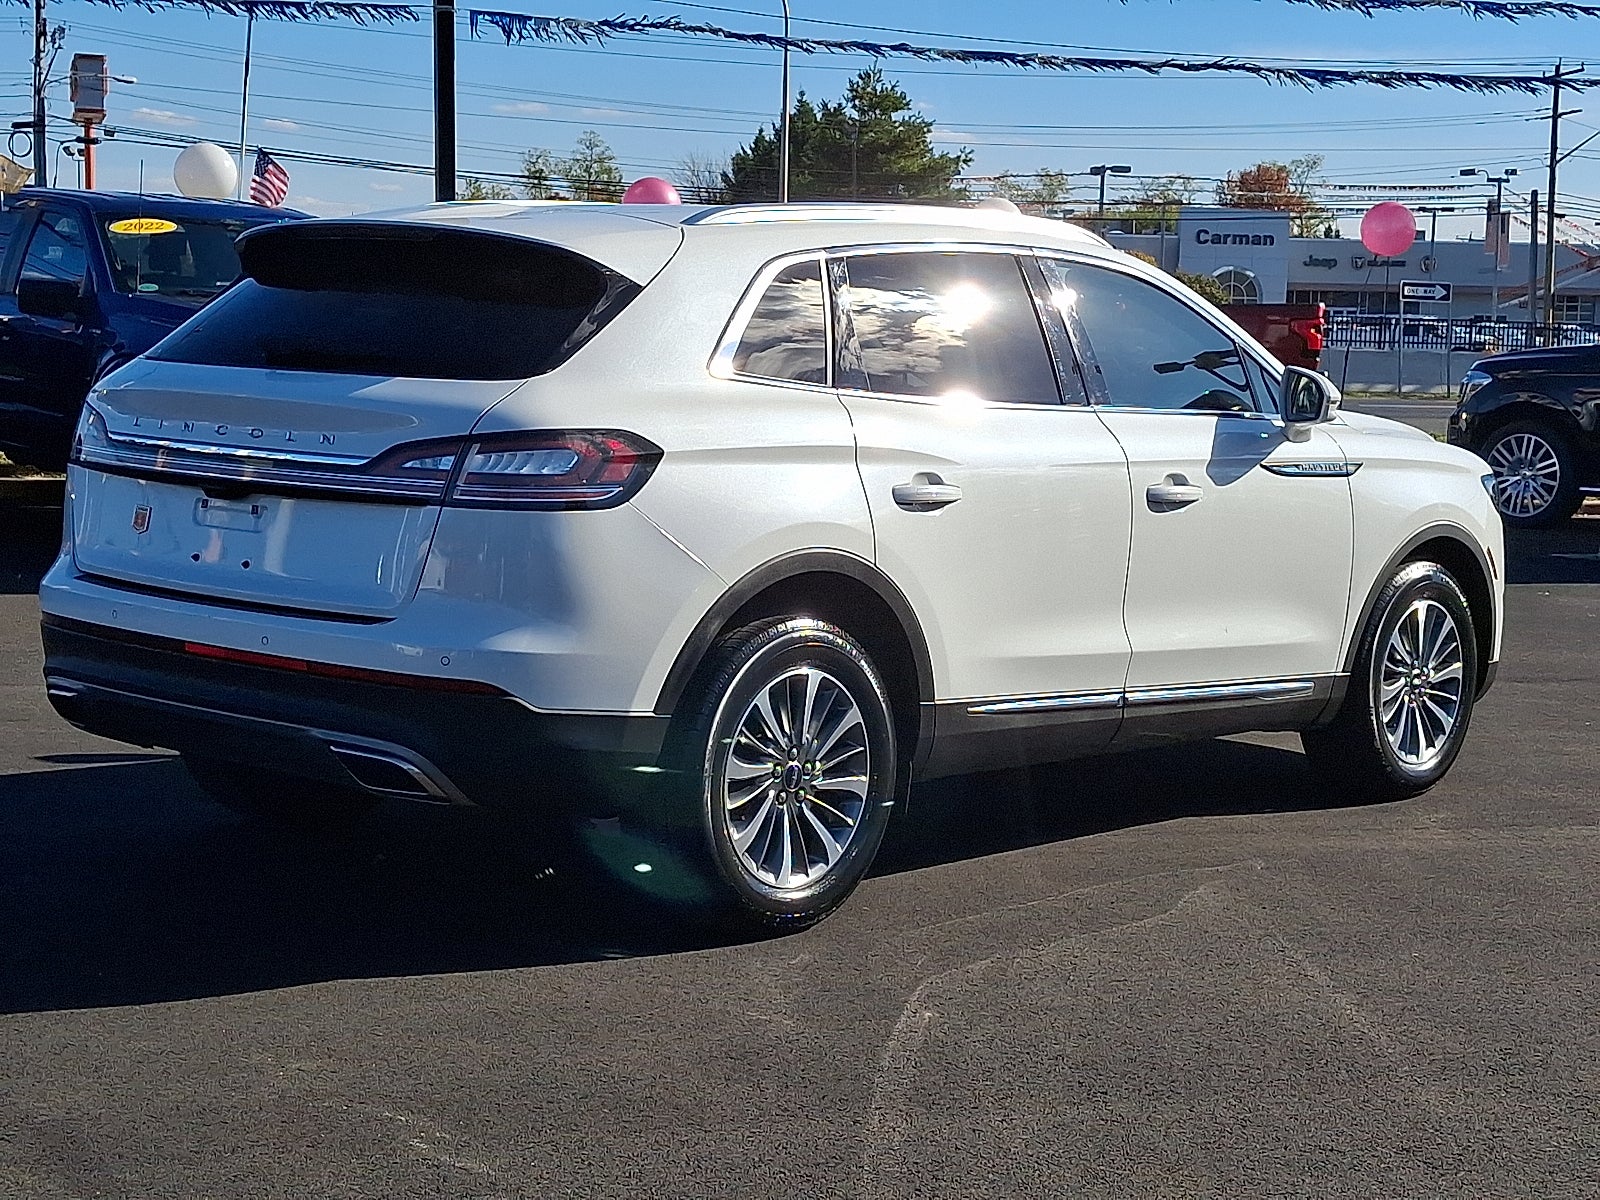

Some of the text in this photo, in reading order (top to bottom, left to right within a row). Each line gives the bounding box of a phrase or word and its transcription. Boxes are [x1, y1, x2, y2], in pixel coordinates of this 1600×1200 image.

[123, 221, 165, 231] 2022
[1196, 228, 1275, 246] Carman
[1302, 254, 1338, 270] Jeep
[1406, 287, 1420, 295] ONE
[133, 416, 336, 445] LINCOLN
